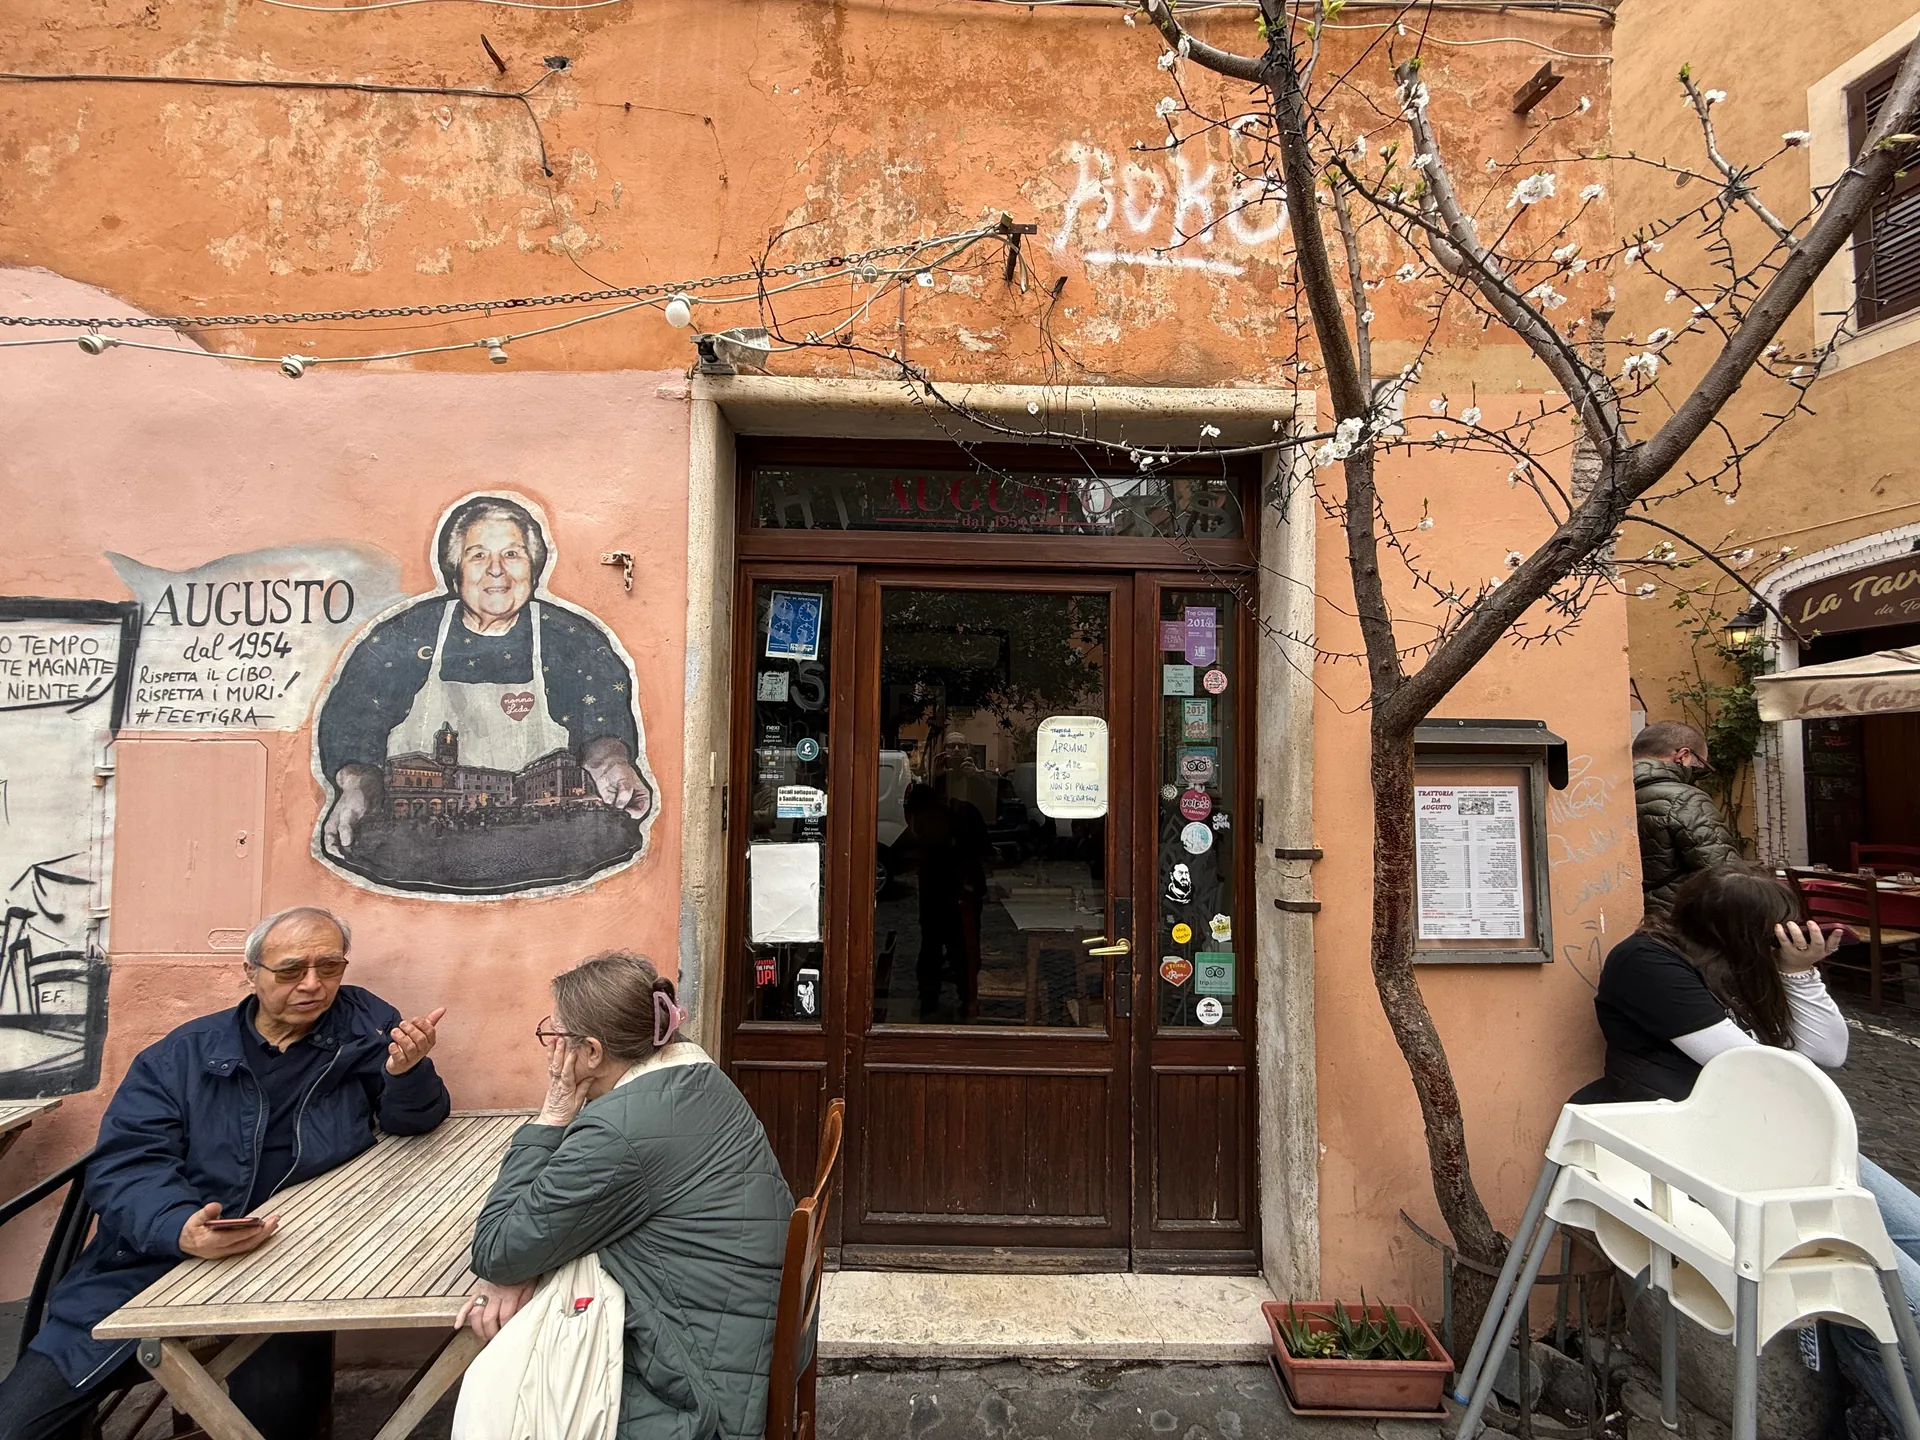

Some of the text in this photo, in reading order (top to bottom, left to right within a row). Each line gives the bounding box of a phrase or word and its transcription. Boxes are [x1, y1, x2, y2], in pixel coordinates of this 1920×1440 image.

[881, 475, 1113, 514] AUGUSTO
[962, 513, 985, 528] dal
[144, 578, 355, 628] AUGUSTO
[1800, 569, 1920, 624] La Tav
[18, 635, 100, 656] TEMPO
[183, 631, 293, 663] dal 1954
[28, 657, 118, 677] MAGNATE
[1797, 679, 1920, 714] La Tav
[1186, 706, 1206, 715] 2013
[1050, 740, 1088, 754] APRIAMO
[1050, 783, 1063, 791] NON
[1065, 783, 1072, 791] SI
[1182, 799, 1200, 809] yelp
[757, 970, 775, 986] UP!
[41, 989, 66, 1004] E.F.
